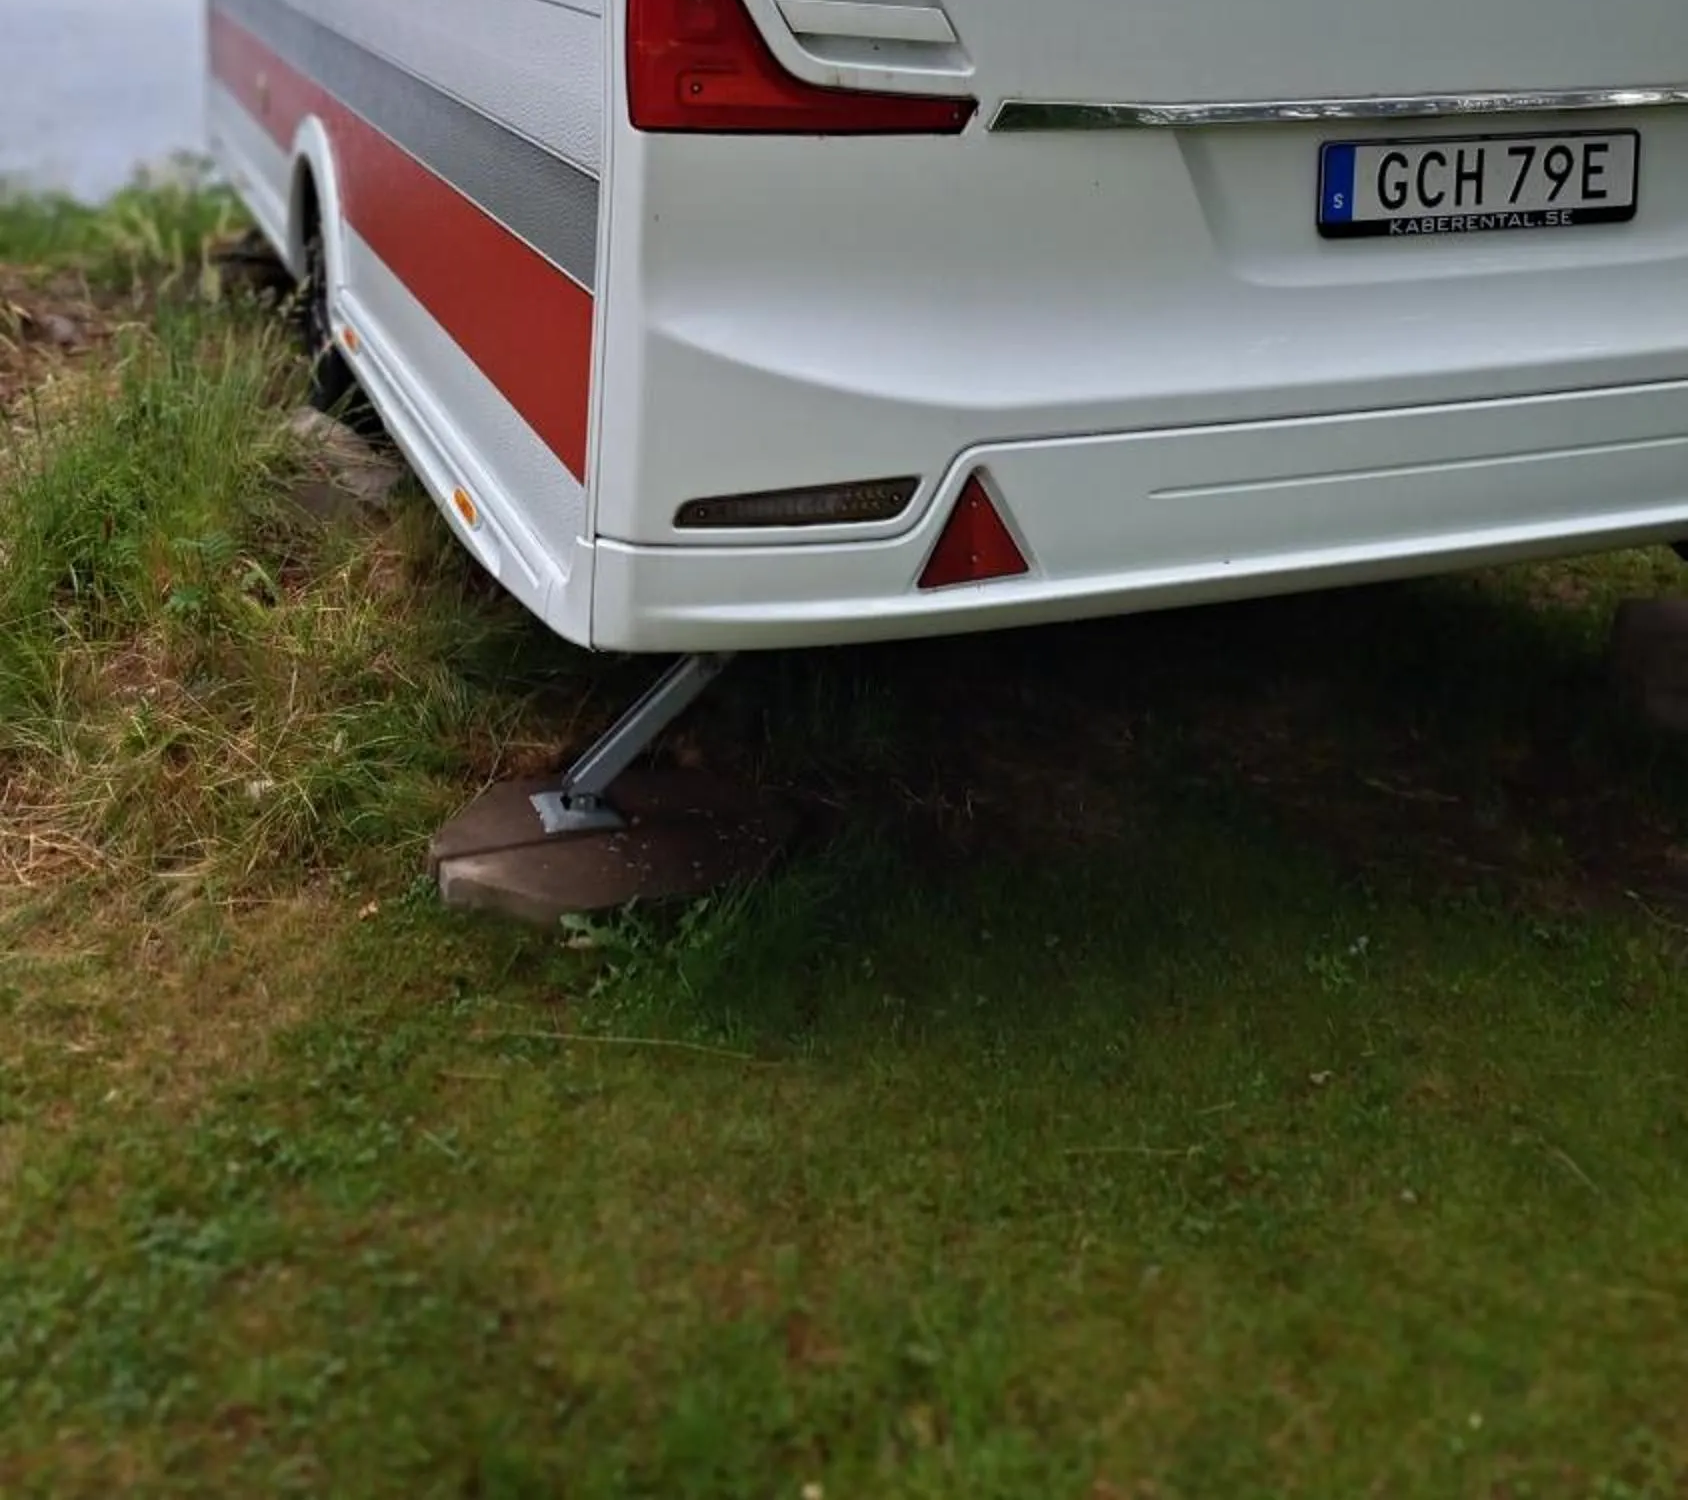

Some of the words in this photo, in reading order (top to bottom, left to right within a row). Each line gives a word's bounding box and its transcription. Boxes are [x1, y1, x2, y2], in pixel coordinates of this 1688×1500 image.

[1377, 148, 1485, 211] GCH
[1507, 143, 1609, 203] 79E
[1333, 193, 1345, 209] S
[1389, 209, 1574, 236] KABERENTAL.SE
